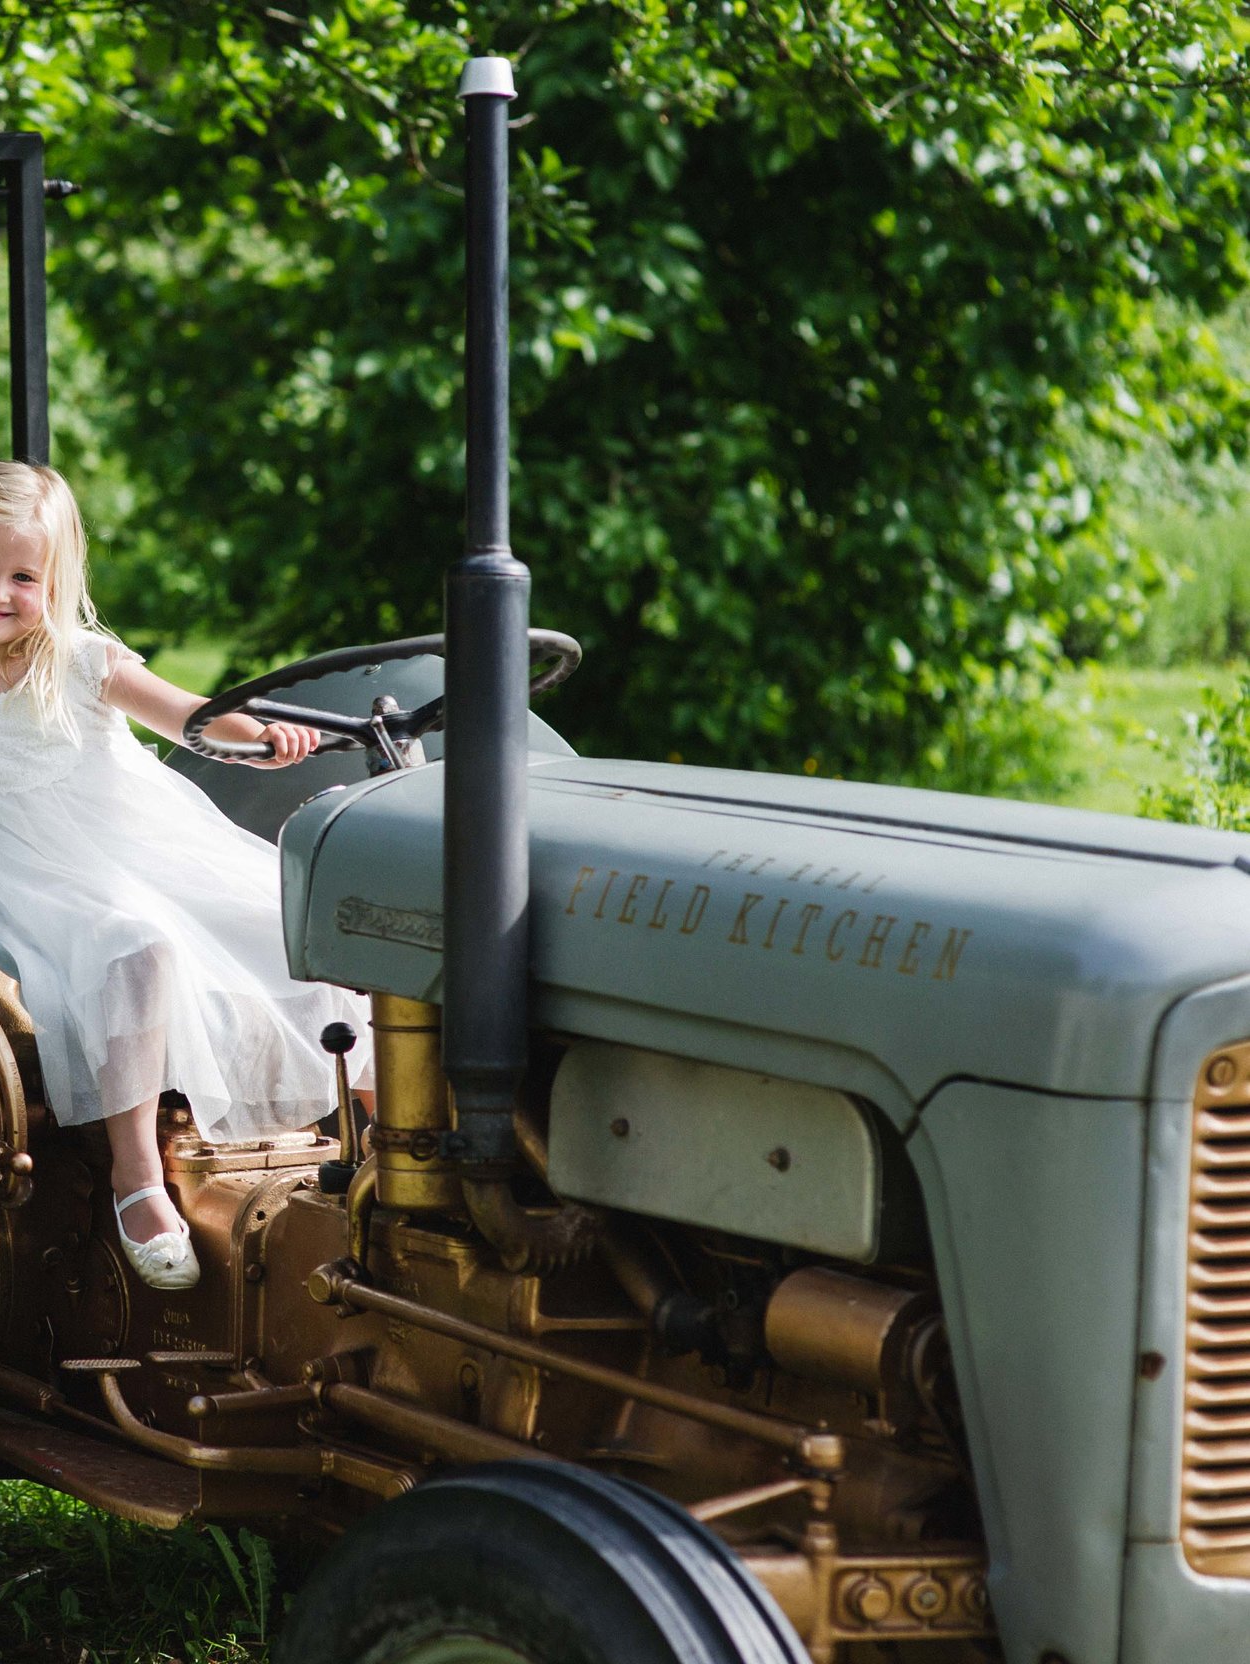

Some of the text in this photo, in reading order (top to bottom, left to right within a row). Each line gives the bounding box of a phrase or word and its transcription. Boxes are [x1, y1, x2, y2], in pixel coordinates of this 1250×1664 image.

[700, 849, 887, 894] THE REAL
[564, 865, 974, 982] FIELD KITCHEN
